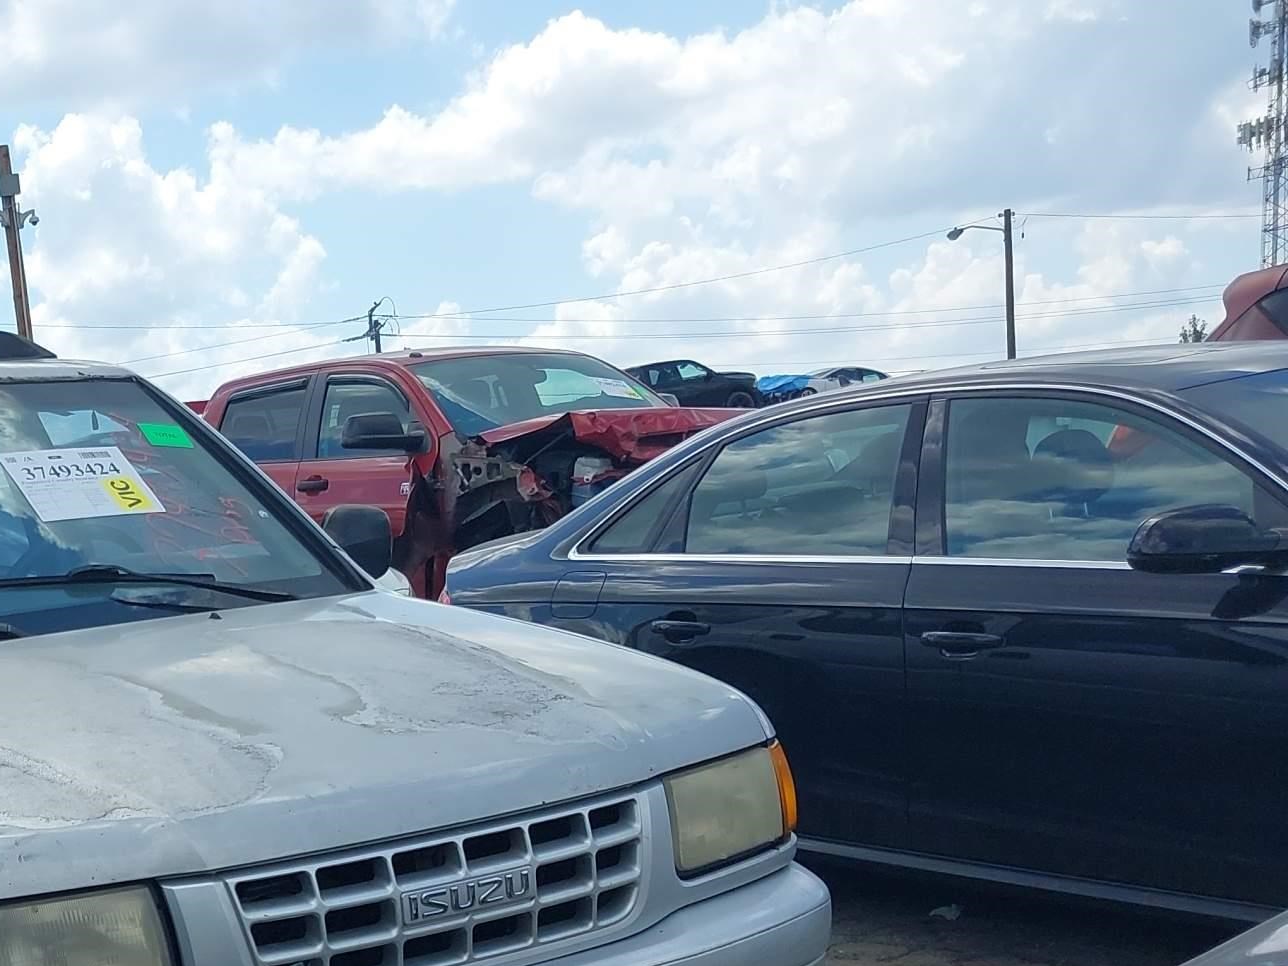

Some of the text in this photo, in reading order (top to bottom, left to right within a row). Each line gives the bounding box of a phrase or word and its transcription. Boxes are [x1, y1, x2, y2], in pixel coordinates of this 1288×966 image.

[21, 462, 121, 480] 37493424
[110, 479, 143, 508] VIC
[408, 870, 529, 920] ISUZU
